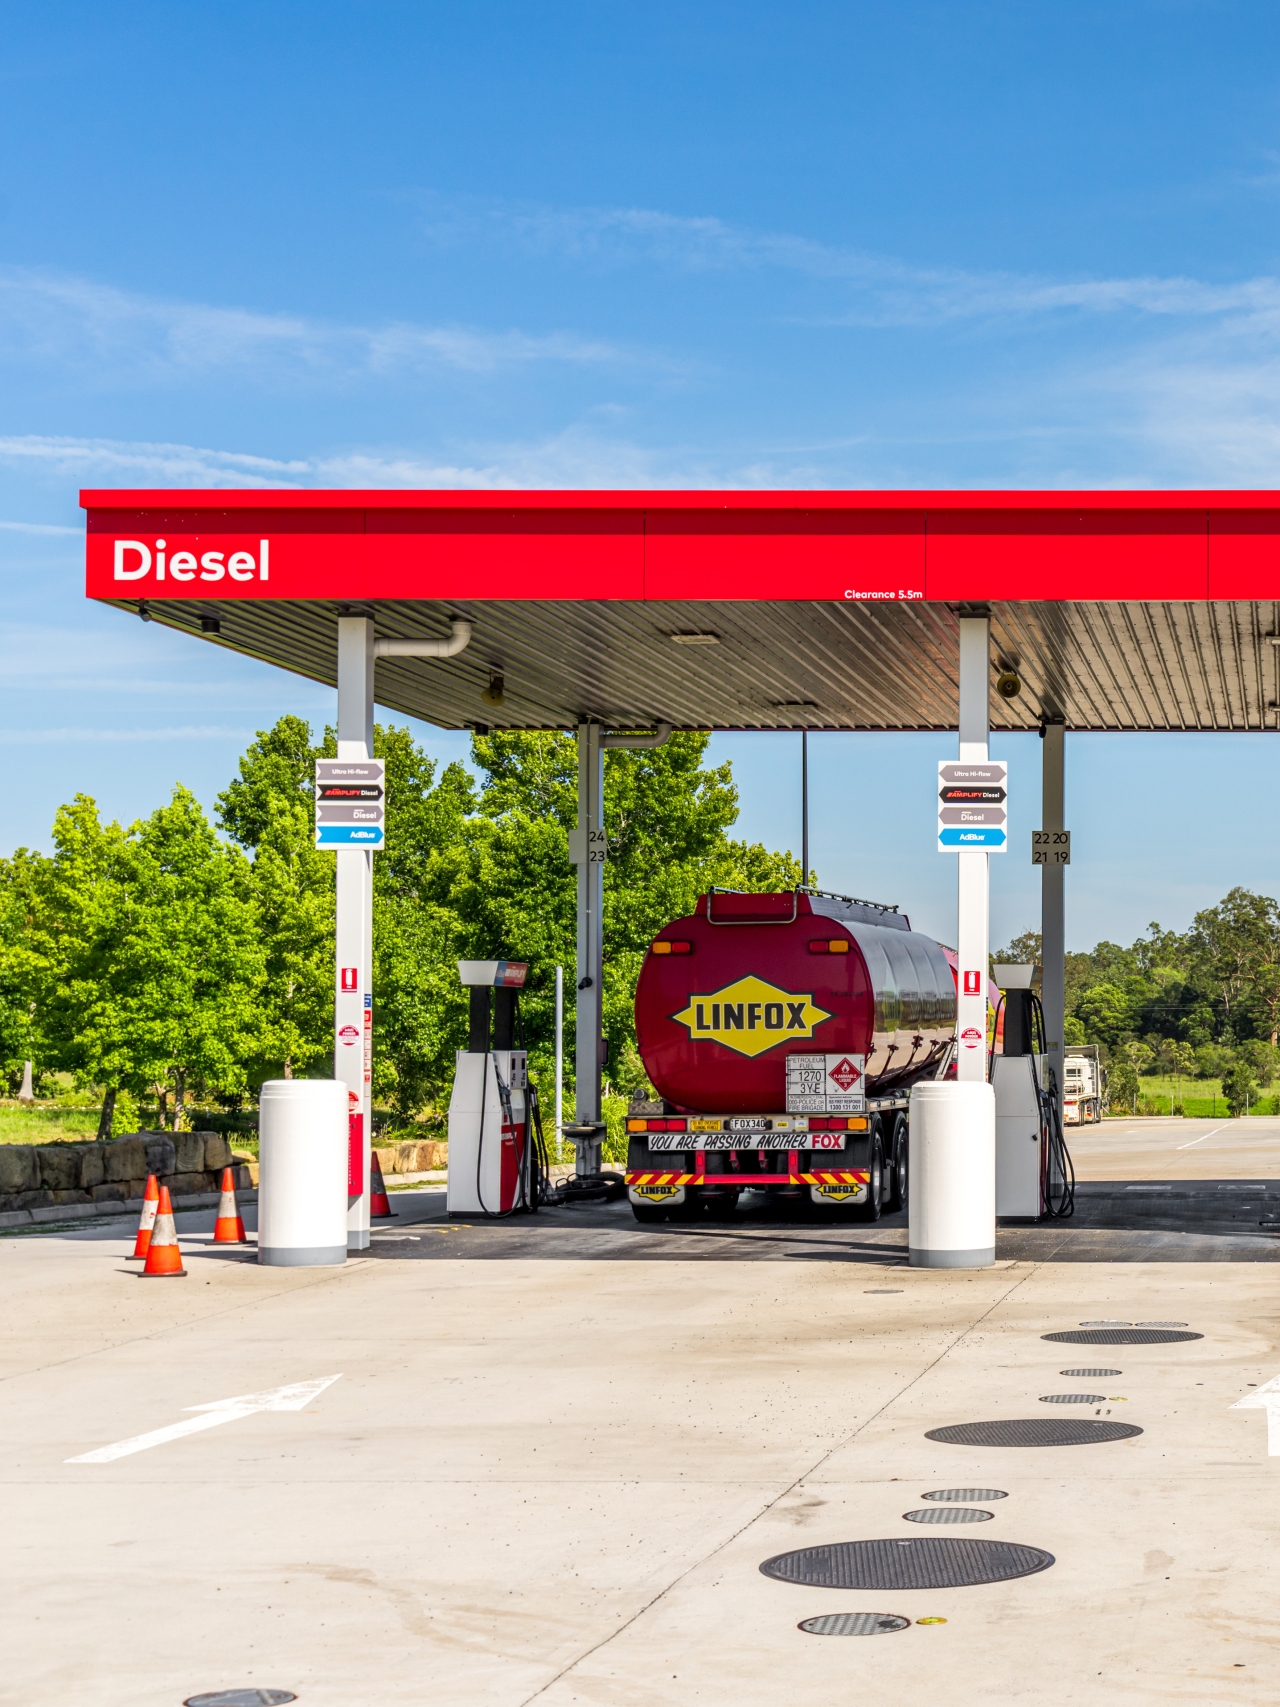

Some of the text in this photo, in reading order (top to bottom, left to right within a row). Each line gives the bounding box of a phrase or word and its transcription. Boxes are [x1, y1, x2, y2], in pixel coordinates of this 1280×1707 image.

[114, 538, 269, 581] Diesel
[844, 589, 923, 599] Clearance 5.5m
[353, 811, 377, 819] Diesel
[589, 831, 605, 842] 24
[1034, 833, 1068, 844] 22 20
[590, 851, 605, 862] 23
[1034, 851, 1069, 863] 21 19
[695, 1002, 807, 1030] LINFOX
[799, 1071, 821, 1081] 1270
[650, 1134, 842, 1150] YOU ARE PASSING ANOTHER FOX
[640, 1186, 672, 1194] LINFOX
[823, 1185, 855, 1193] LINFOX
